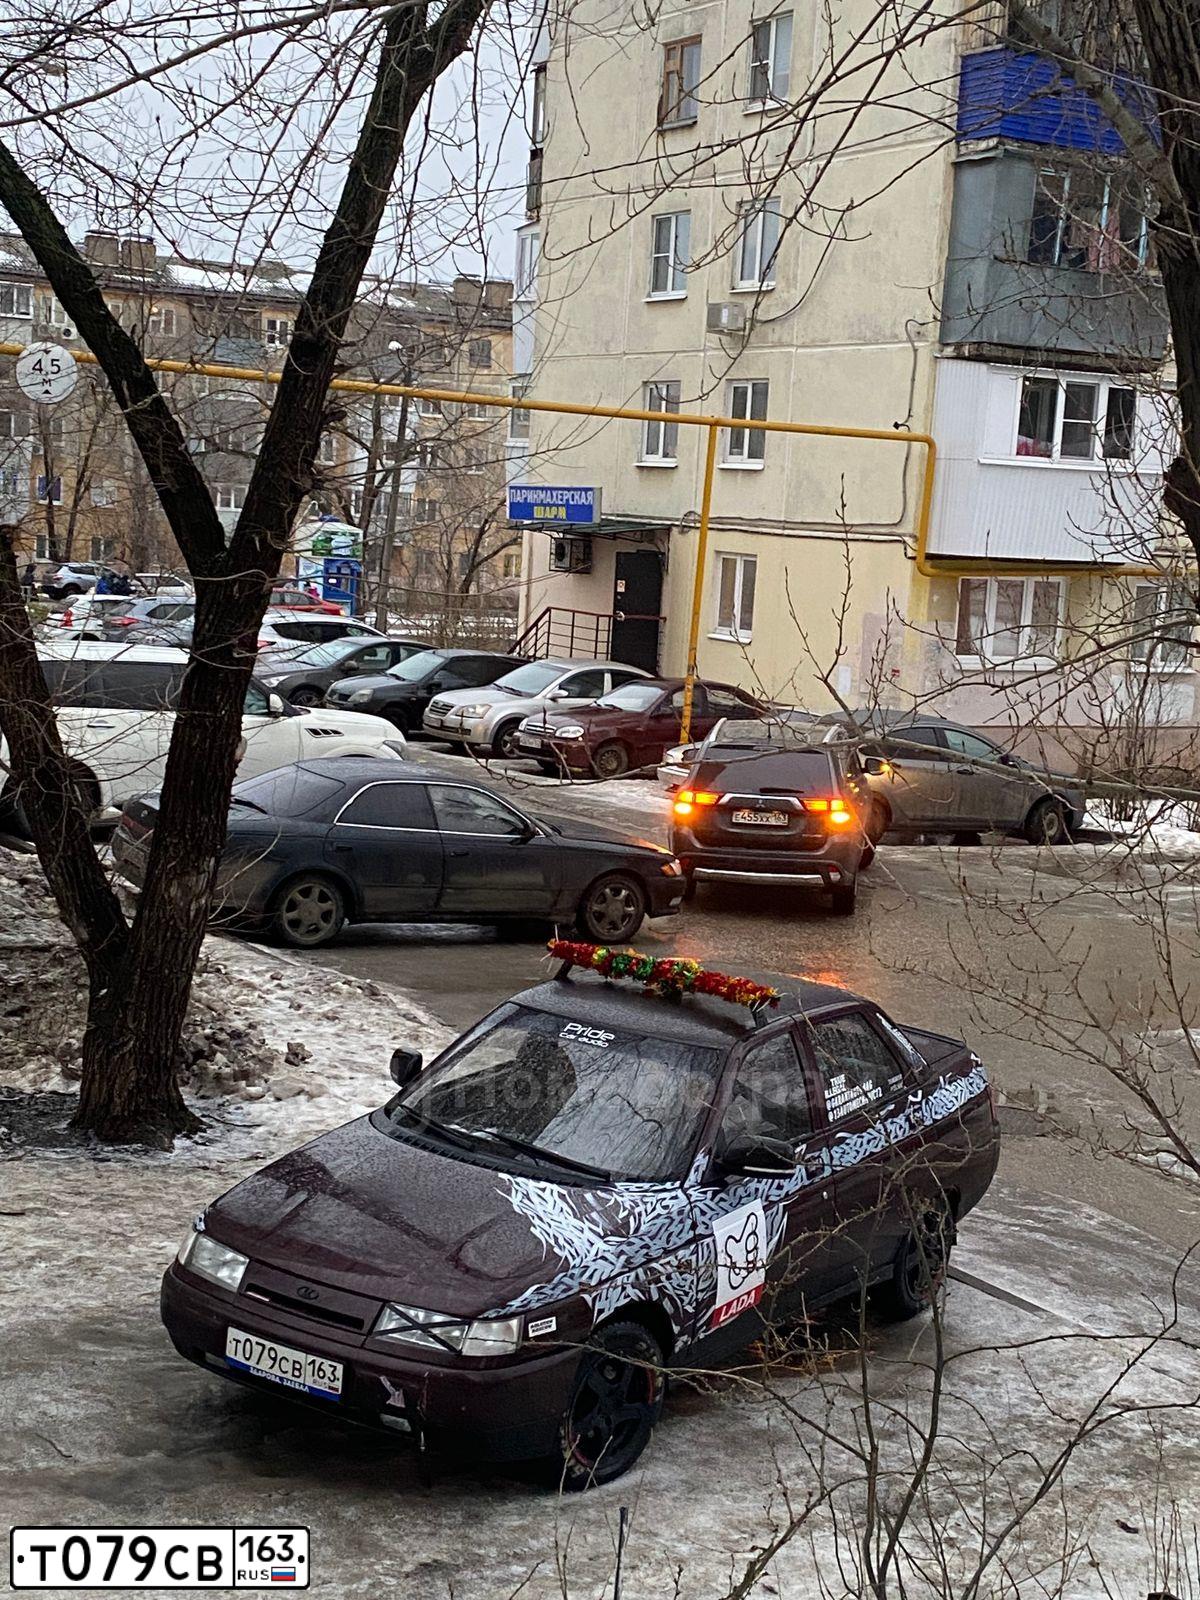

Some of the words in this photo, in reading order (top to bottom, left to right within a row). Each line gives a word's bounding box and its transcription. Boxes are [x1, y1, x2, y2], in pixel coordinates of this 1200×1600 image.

[510, 489, 593, 505] ПАРИКМАХЕРСКАЯ
[563, 1022, 615, 1041] Pride
[719, 1290, 756, 1321] LADA
[232, 1337, 303, 1379] Т079СВ
[307, 1359, 338, 1383] 163
